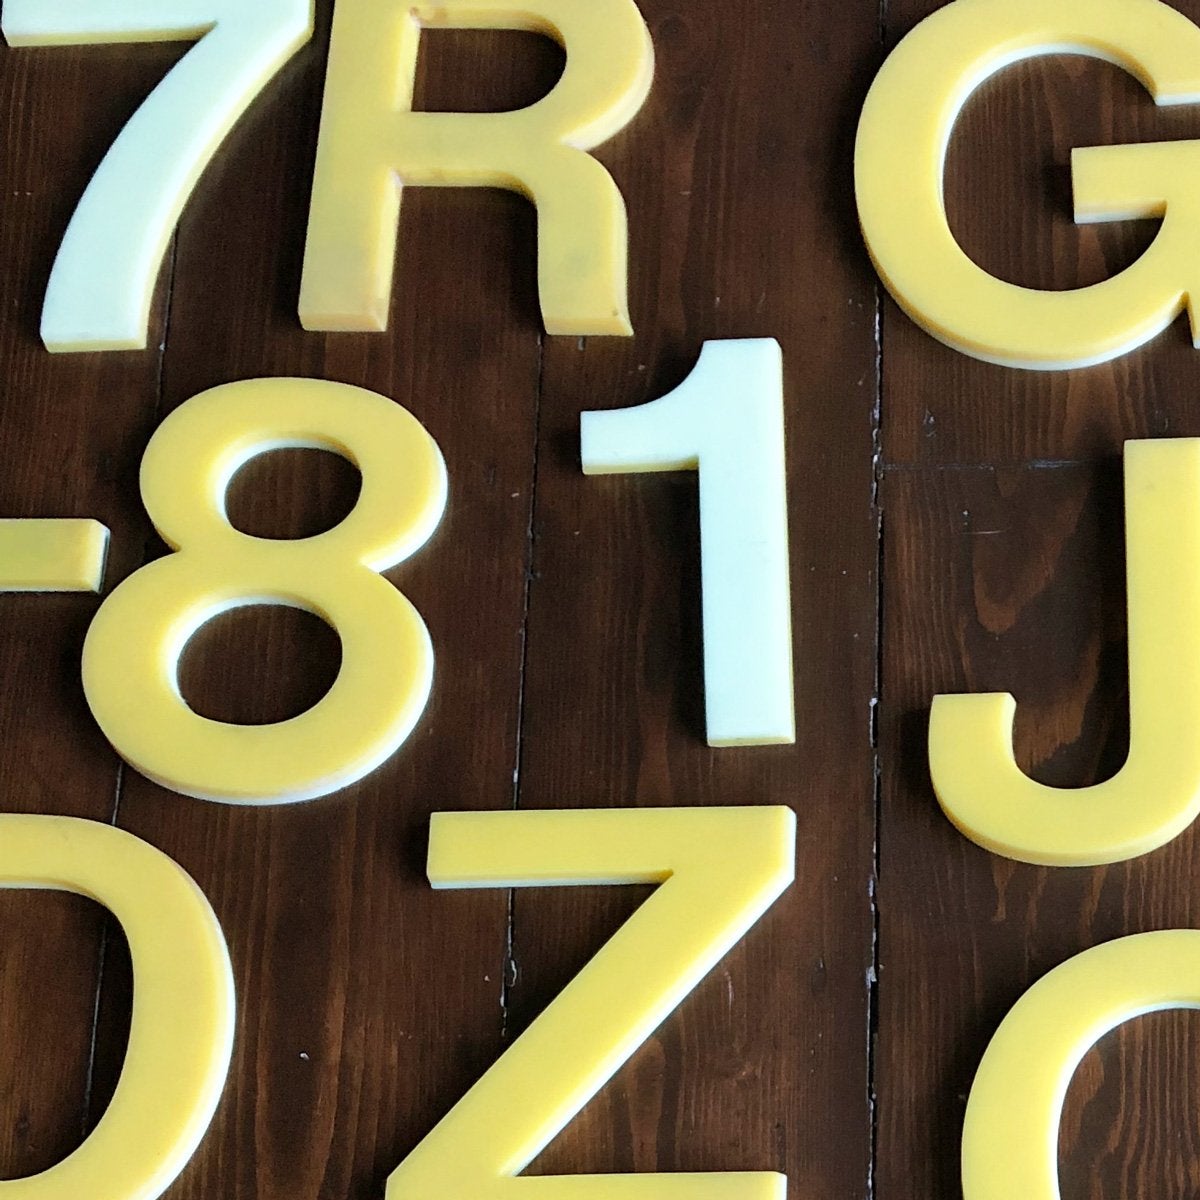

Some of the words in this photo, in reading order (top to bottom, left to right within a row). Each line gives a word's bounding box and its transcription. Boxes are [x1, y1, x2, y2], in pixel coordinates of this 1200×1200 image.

[1, 0, 314, 353] 7
[298, 0, 656, 337] R
[81, 377, 448, 806] 8
[579, 337, 796, 748] 1
